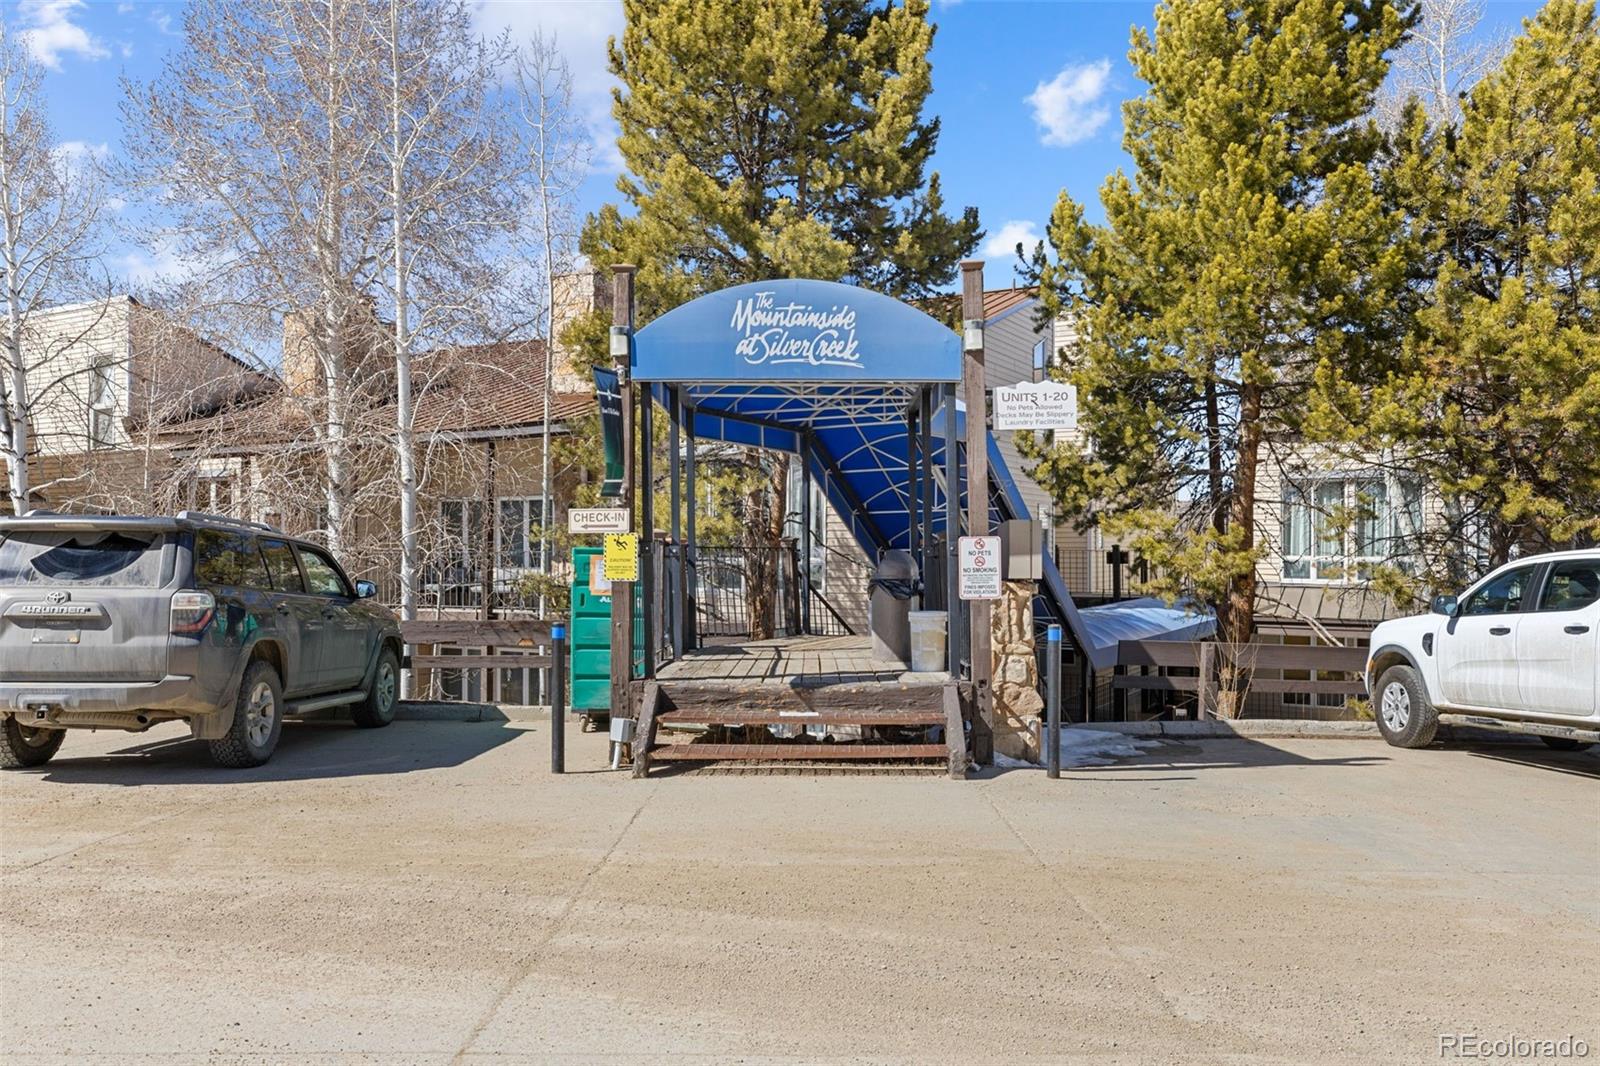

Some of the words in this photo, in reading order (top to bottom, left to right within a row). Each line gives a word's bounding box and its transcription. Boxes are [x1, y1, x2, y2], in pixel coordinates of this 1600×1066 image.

[755, 291, 776, 309] The
[730, 298, 856, 337] Mountainside
[735, 333, 762, 355] at
[744, 328, 811, 364] Silver
[808, 329, 860, 365] Creek
[1001, 392, 1038, 402] UNITS
[1043, 391, 1069, 401] 1-20
[1018, 411, 1033, 419] May
[1046, 411, 1074, 419] Slippery
[573, 512, 625, 523] CHECK-IN
